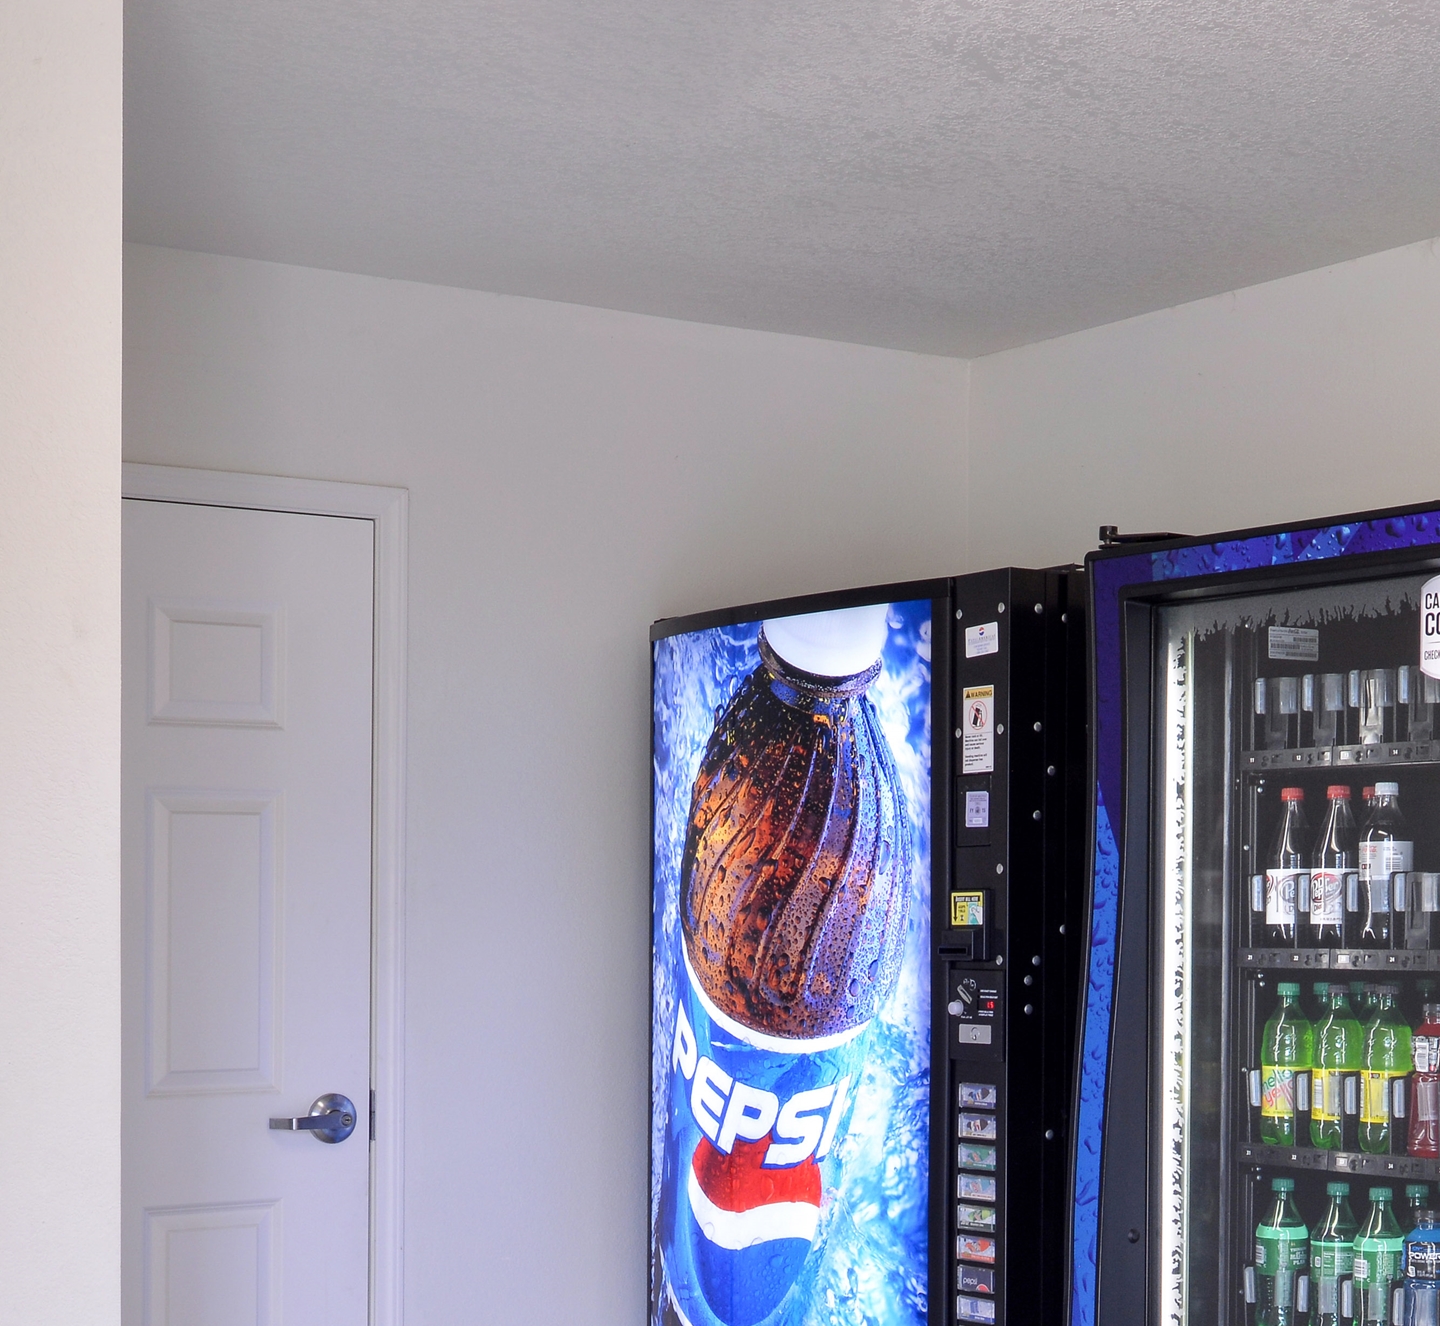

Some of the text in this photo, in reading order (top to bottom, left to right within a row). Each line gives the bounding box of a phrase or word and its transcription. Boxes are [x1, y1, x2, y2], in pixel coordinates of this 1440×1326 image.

[1424, 649, 1440, 660] CHECK
[970, 689, 992, 698] WARNING
[672, 999, 851, 1165] PEPSI
[962, 1276, 978, 1286] pepsi
